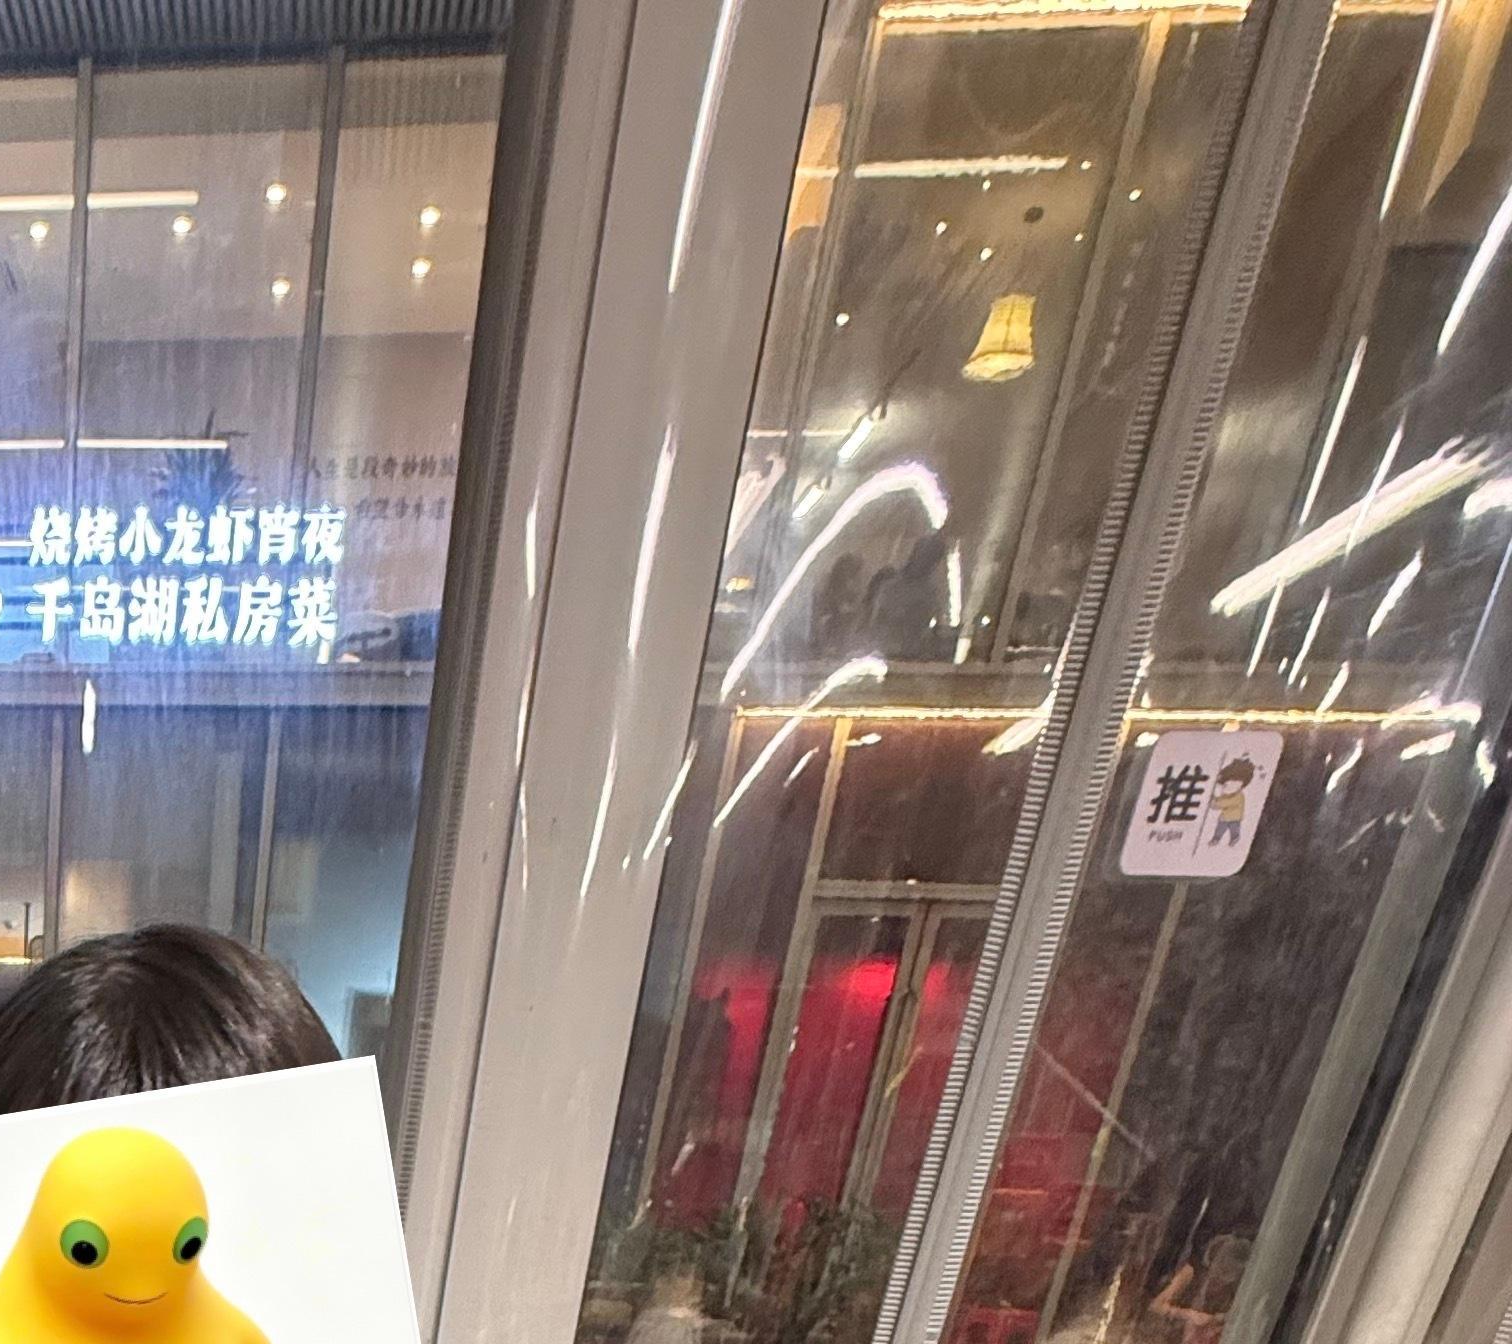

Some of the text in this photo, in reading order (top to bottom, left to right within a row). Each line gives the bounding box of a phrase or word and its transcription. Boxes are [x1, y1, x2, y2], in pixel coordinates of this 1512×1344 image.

[28, 503, 346, 567] 烧烤小龙虾宵夜
[25, 574, 339, 647] 千岛湖私房菜
[1147, 764, 1209, 823] 推
